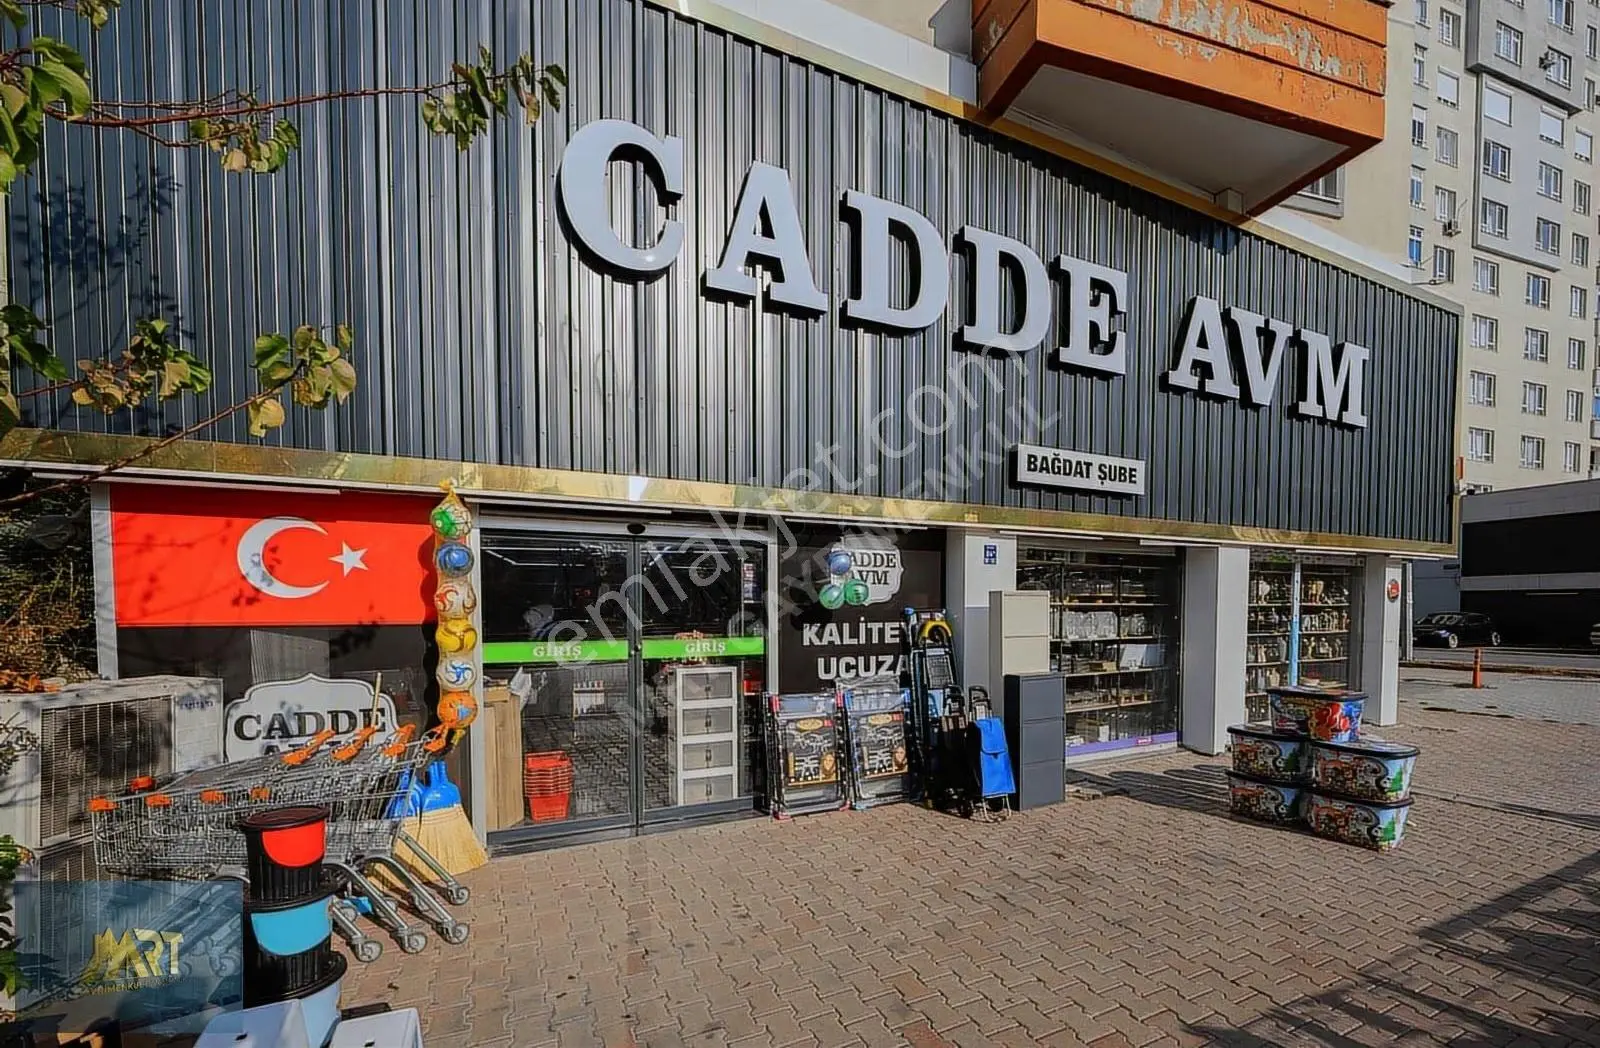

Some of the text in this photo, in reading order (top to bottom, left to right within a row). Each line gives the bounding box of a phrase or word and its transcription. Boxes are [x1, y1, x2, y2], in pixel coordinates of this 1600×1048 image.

[558, 118, 1370, 430] CADDE AVM
[1026, 452, 1137, 485] BAĞDAT ŞUBE
[233, 708, 386, 741] CADDE
